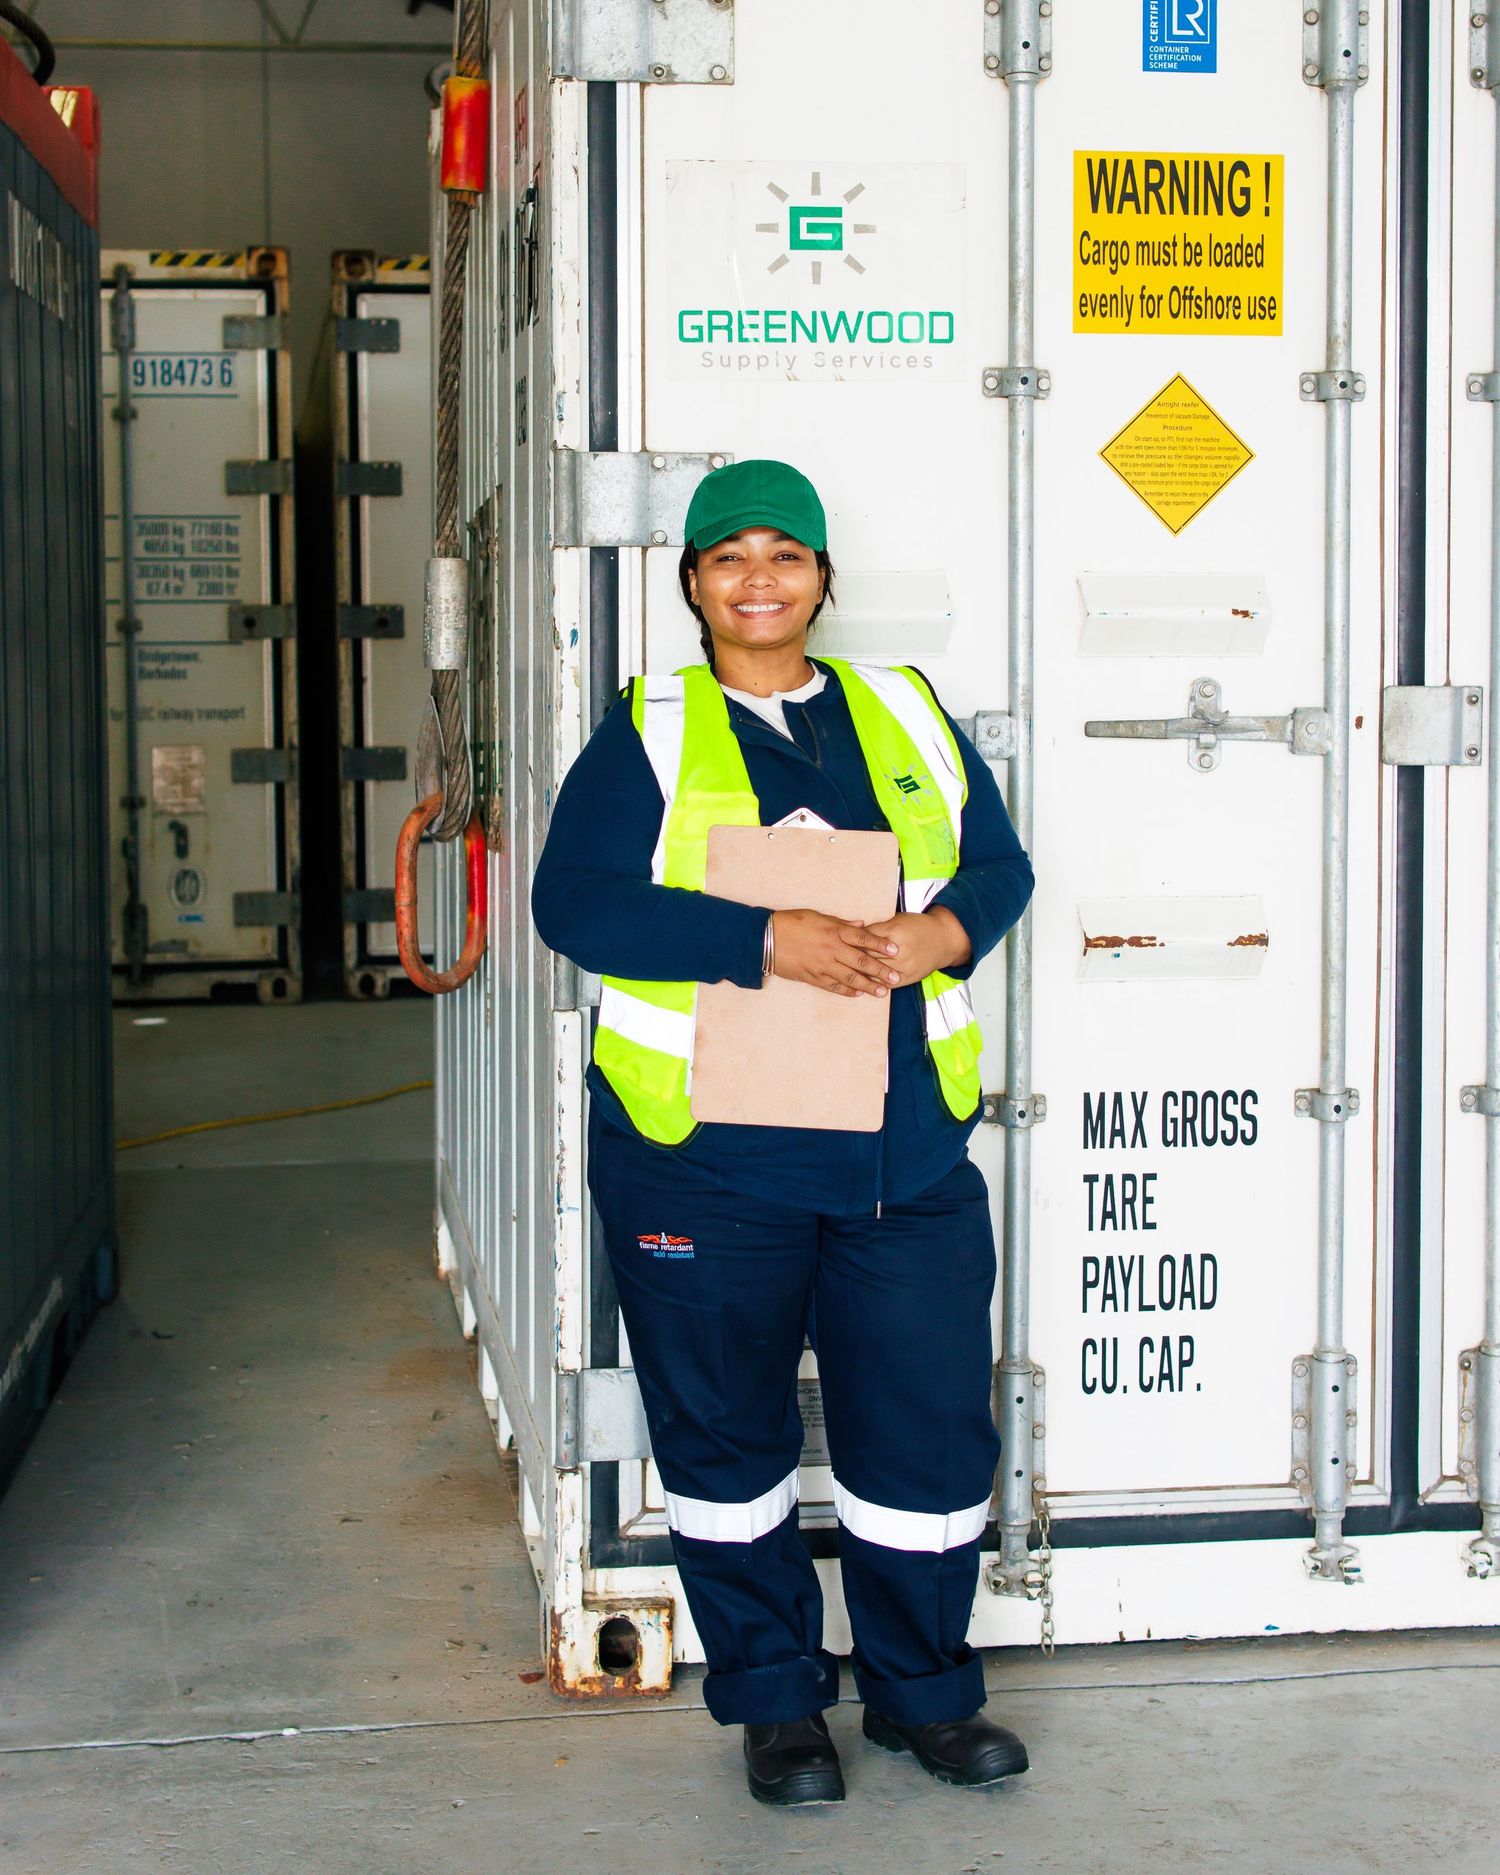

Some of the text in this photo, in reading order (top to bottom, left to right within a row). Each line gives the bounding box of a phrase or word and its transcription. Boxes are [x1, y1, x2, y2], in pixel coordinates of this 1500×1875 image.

[1149, 54, 1202, 62] CERTIFICATION
[1086, 158, 1251, 217] WARNING
[1079, 230, 1264, 275] Cargo must be loaded
[678, 310, 954, 344] GREENWOOD
[1079, 284, 1277, 328] evenly for Offshore use
[133, 358, 212, 386] 918473
[701, 351, 934, 372] Supply Services
[1082, 1089, 1258, 1149] MAX GROSS
[1082, 1173, 1158, 1231] TARE
[1082, 1254, 1217, 1313] PAYLOAD
[1081, 1335, 1201, 1395] CU. CAP.
